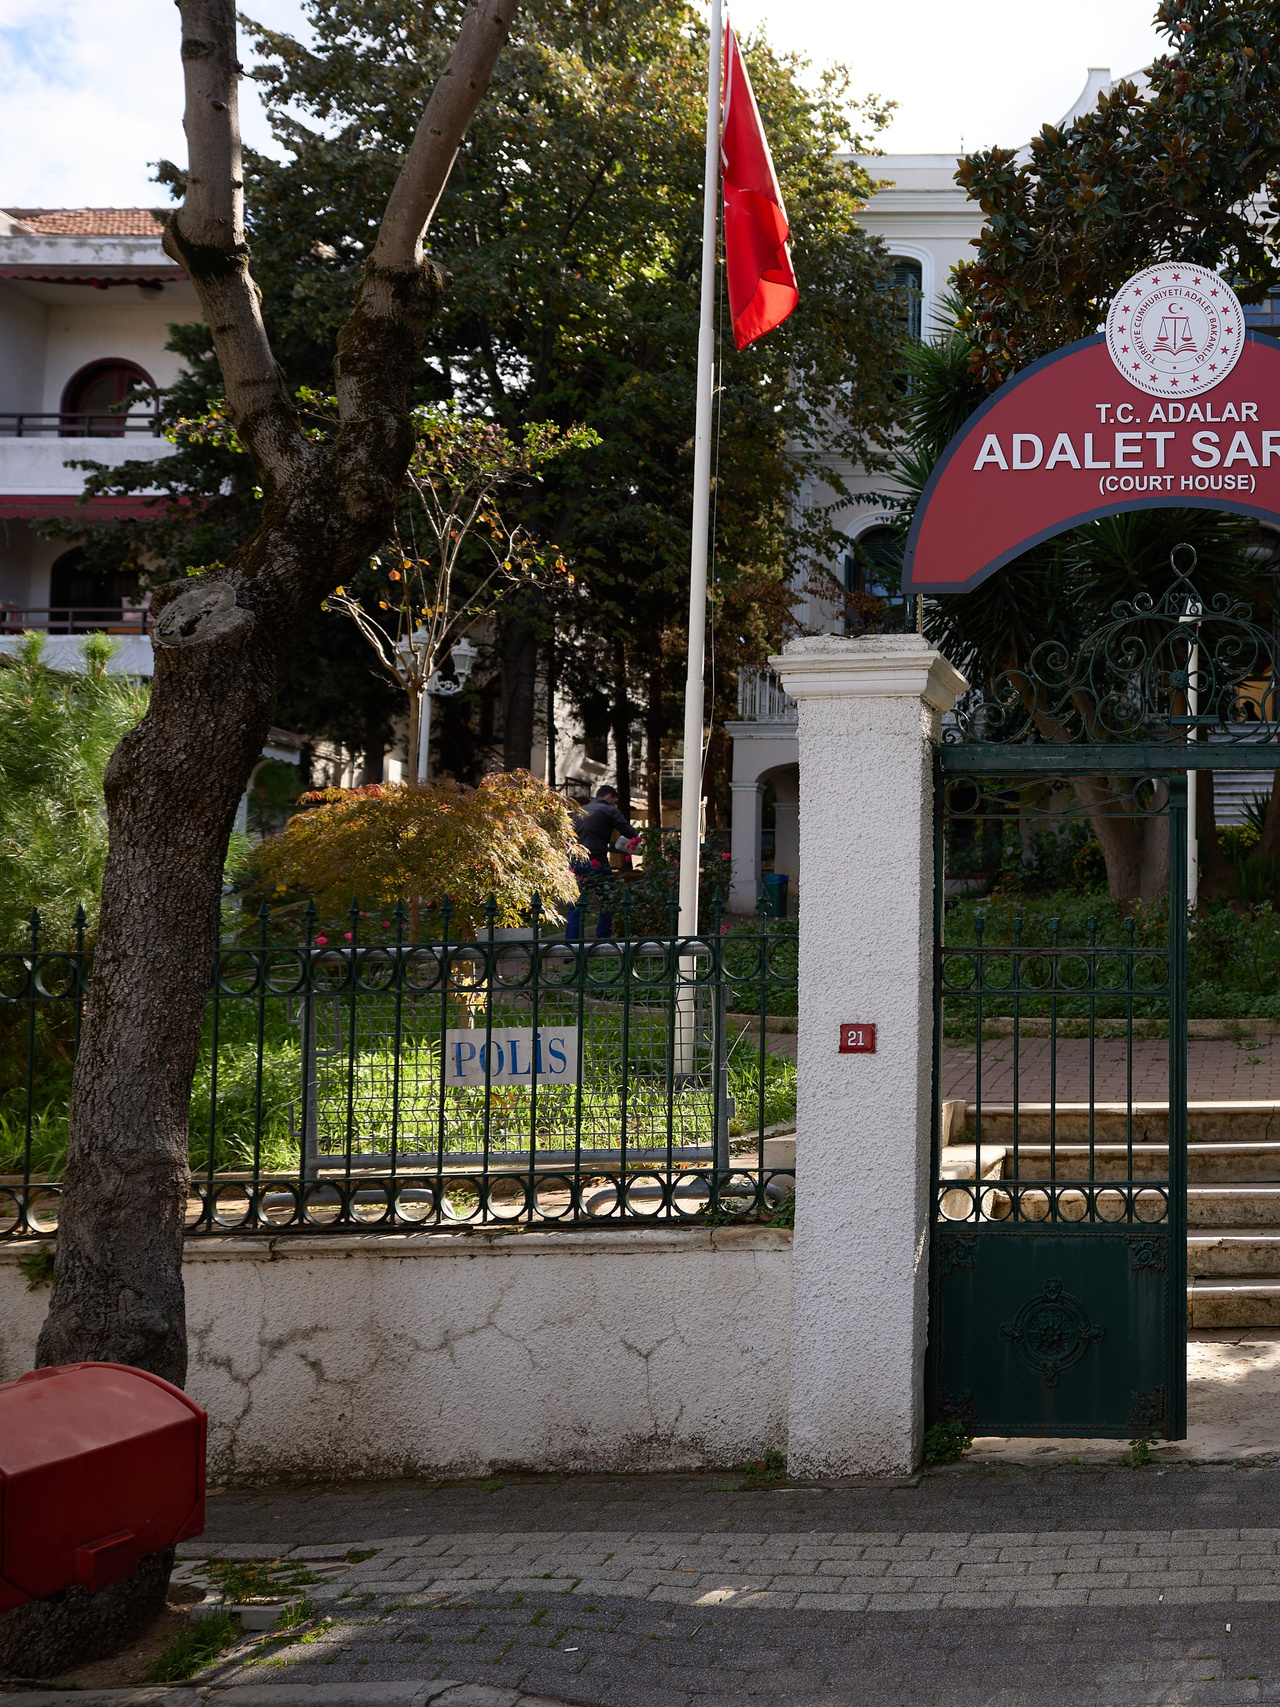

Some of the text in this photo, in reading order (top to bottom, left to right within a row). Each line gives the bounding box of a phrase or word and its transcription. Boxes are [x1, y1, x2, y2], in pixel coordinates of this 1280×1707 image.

[1133, 288, 1218, 365] TÜRKİYE CUMHURİYETİ ADALET BAKANLIĞI
[1095, 402, 1259, 424] T.C. ADALAR
[973, 431, 1175, 471] ADALET
[1099, 474, 1257, 495] (COURT HOUSE)
[1164, 592, 1199, 615] 1878
[846, 1030, 865, 1046] 21
[451, 1032, 567, 1078] POLİS
